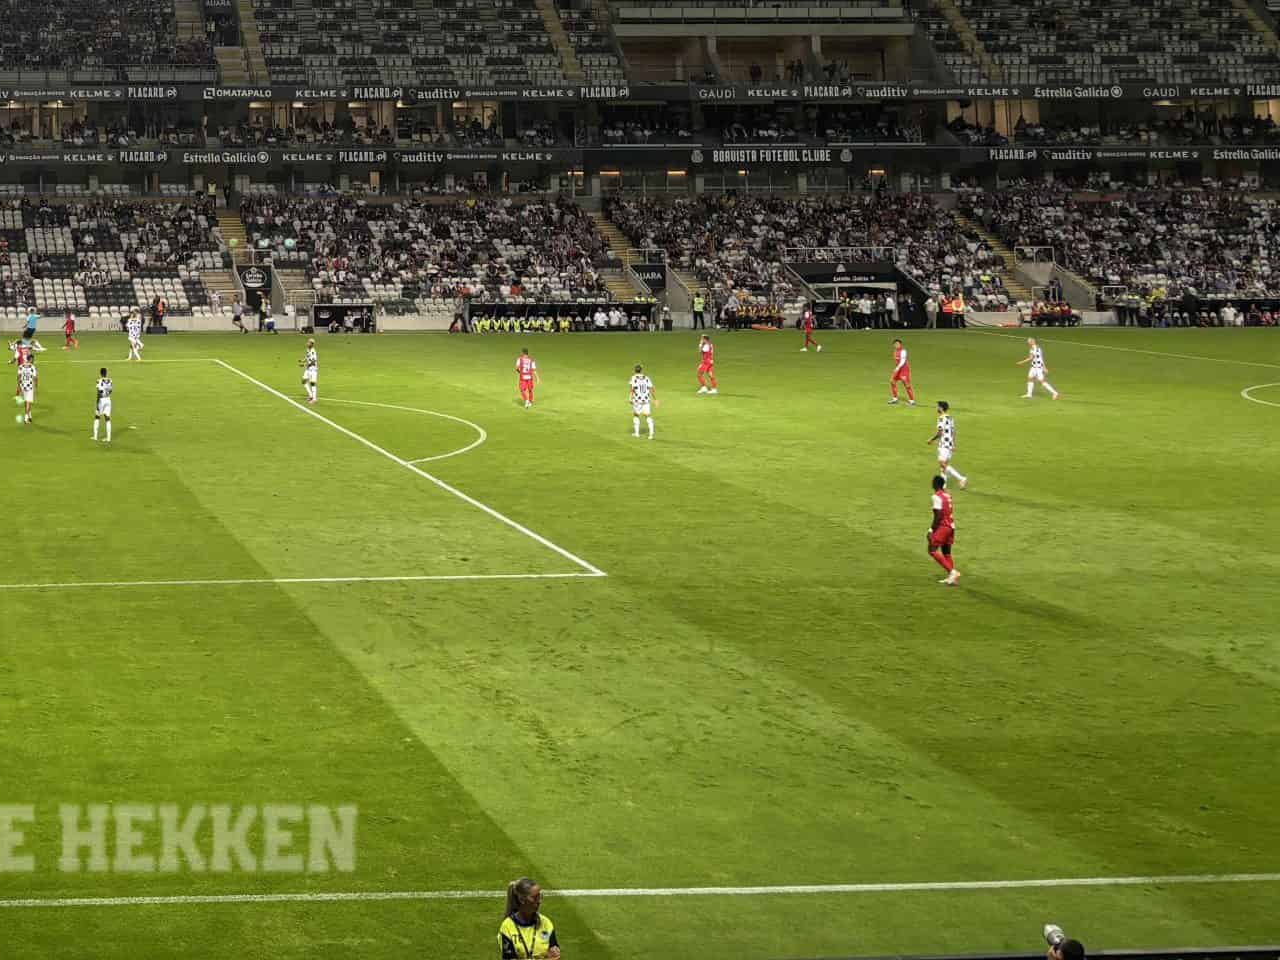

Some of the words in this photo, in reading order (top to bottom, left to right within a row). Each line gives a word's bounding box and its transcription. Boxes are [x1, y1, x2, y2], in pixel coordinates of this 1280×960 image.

[417, 88, 460, 99] auditiv
[865, 86, 908, 97] auditiv
[1034, 87, 1072, 97] Estrella
[1074, 86, 1109, 97] Galicia
[183, 152, 221, 163] Estrella
[222, 152, 257, 163] Galicia
[401, 152, 443, 162] auditiv
[712, 149, 757, 162] BOAVISTA
[802, 149, 831, 162] CLUBE
[1051, 150, 1092, 160] auditiv
[1213, 149, 1249, 160] Estrella
